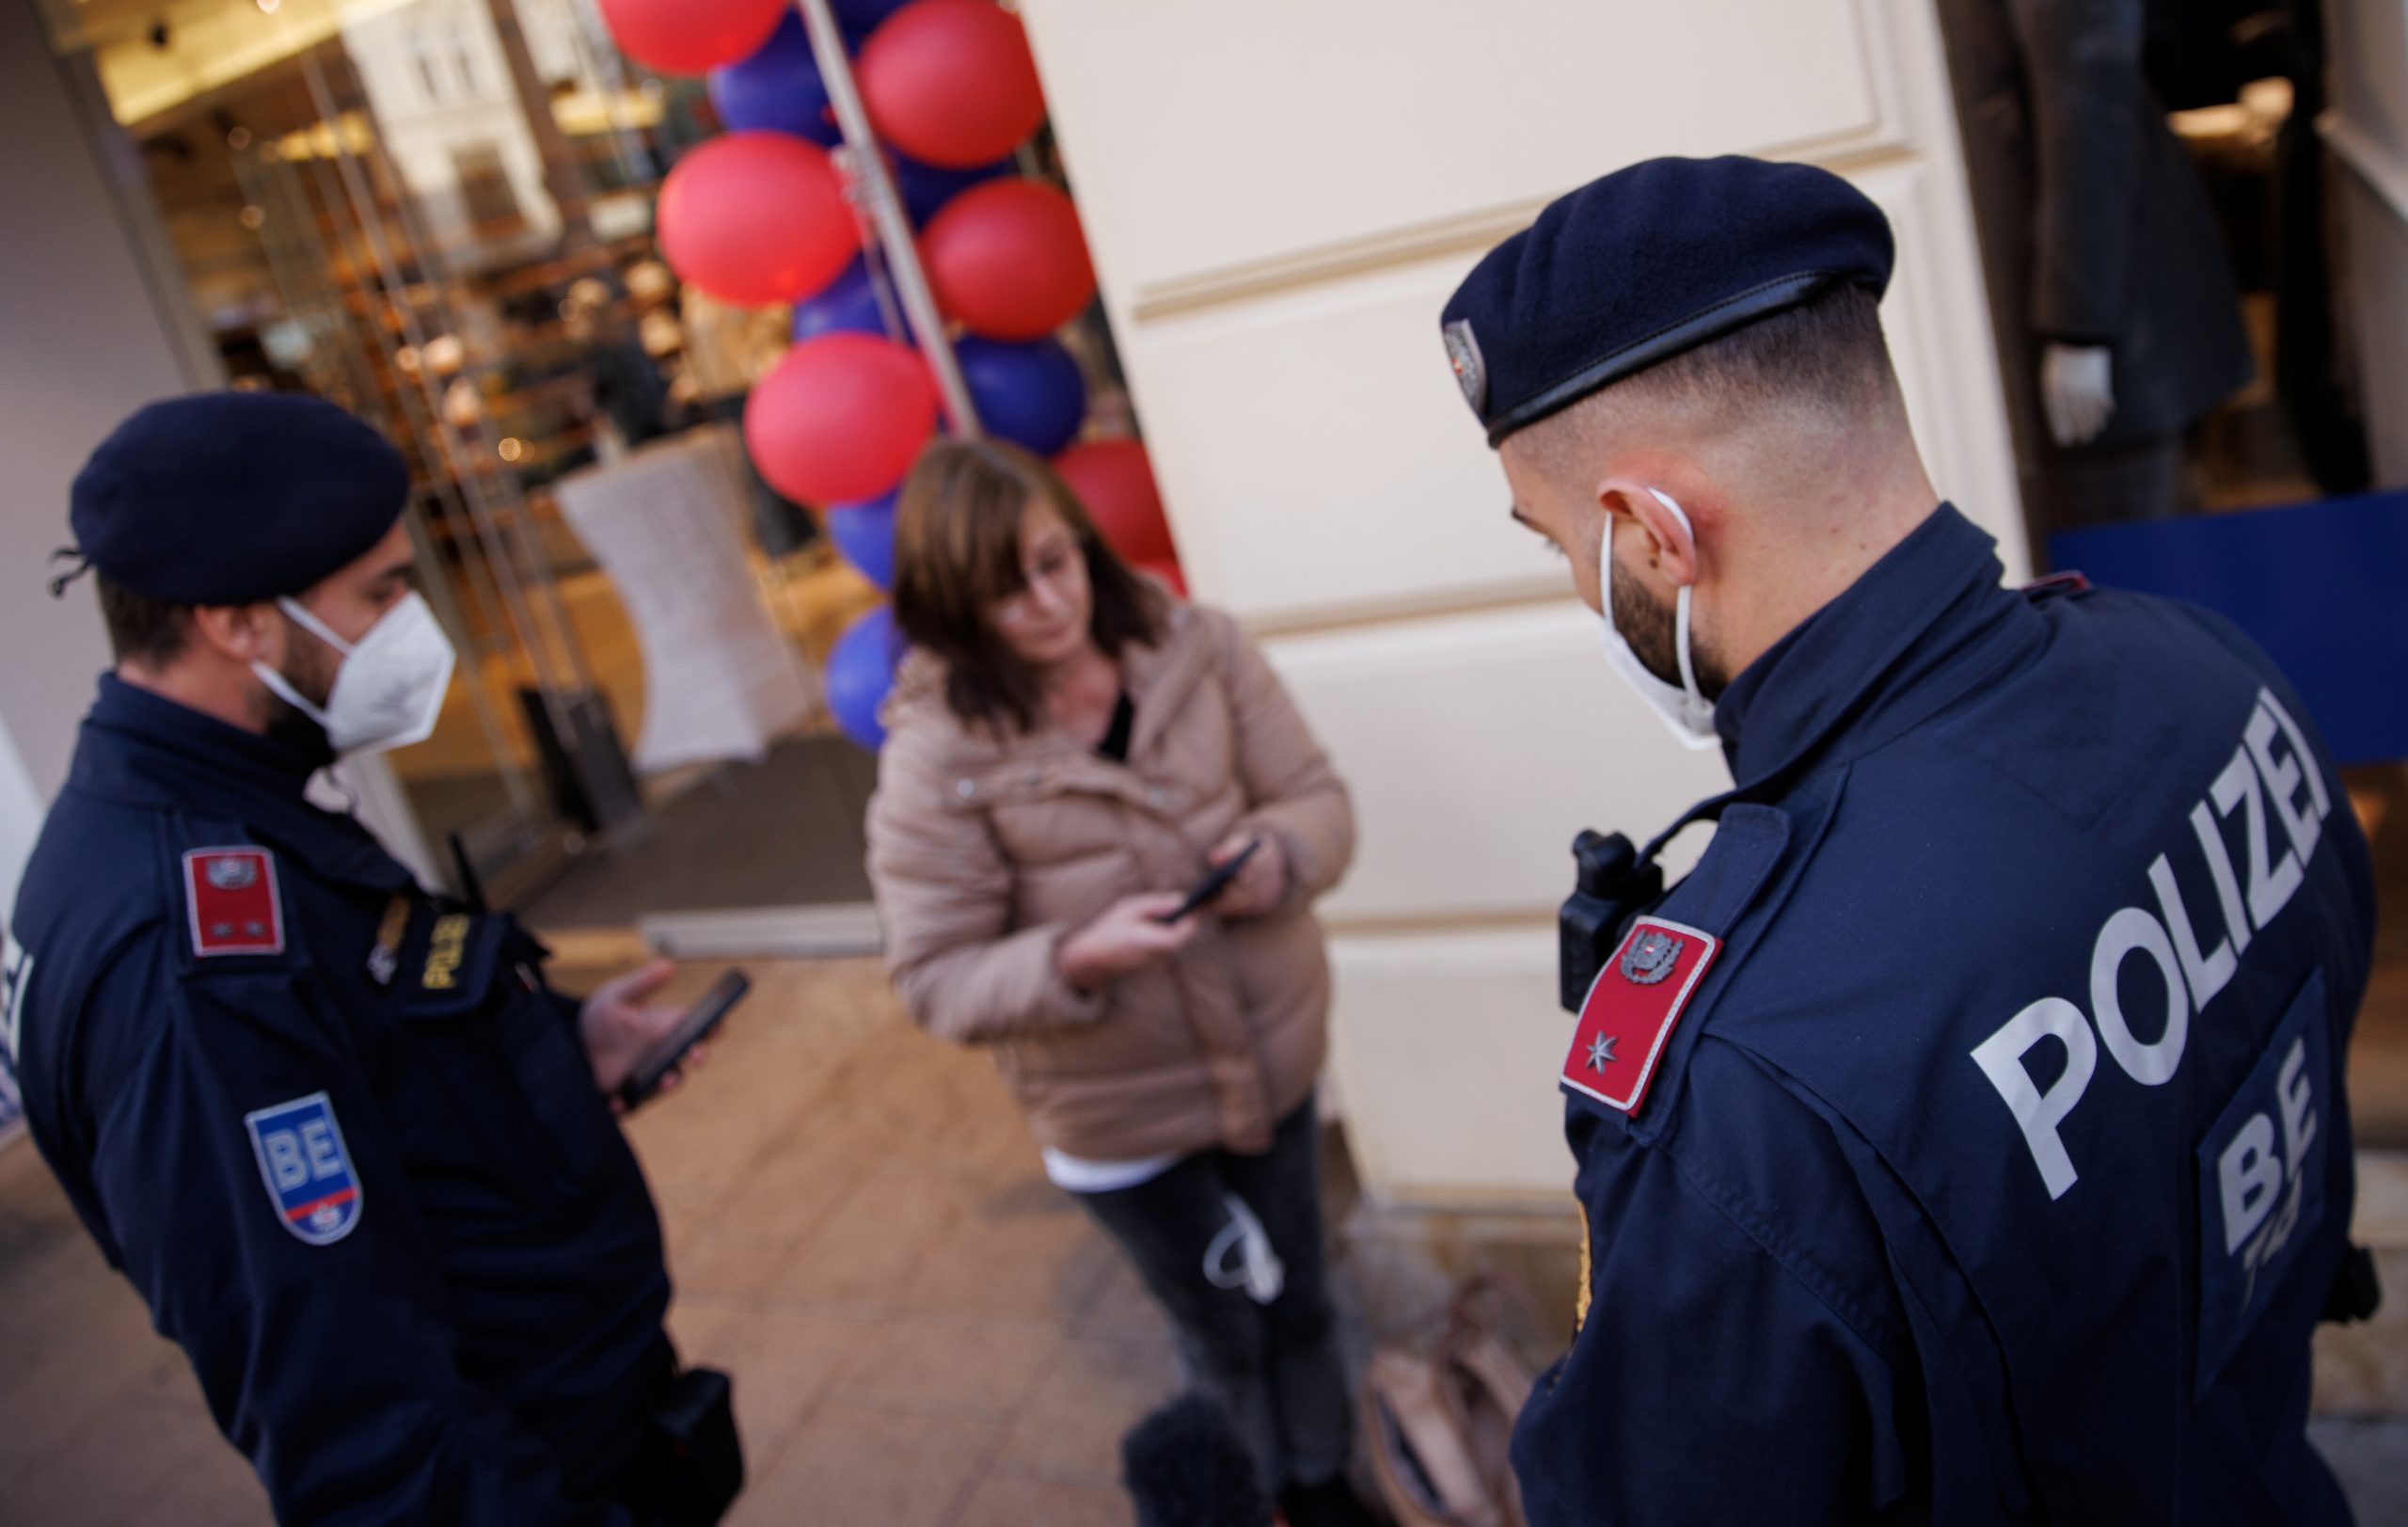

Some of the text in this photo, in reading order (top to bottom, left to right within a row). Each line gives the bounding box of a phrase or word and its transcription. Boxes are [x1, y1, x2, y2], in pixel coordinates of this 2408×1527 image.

[1971, 686, 2331, 1201] POLIZEI
[263, 1118, 342, 1192] BE
[2219, 1037, 2318, 1256] BE
